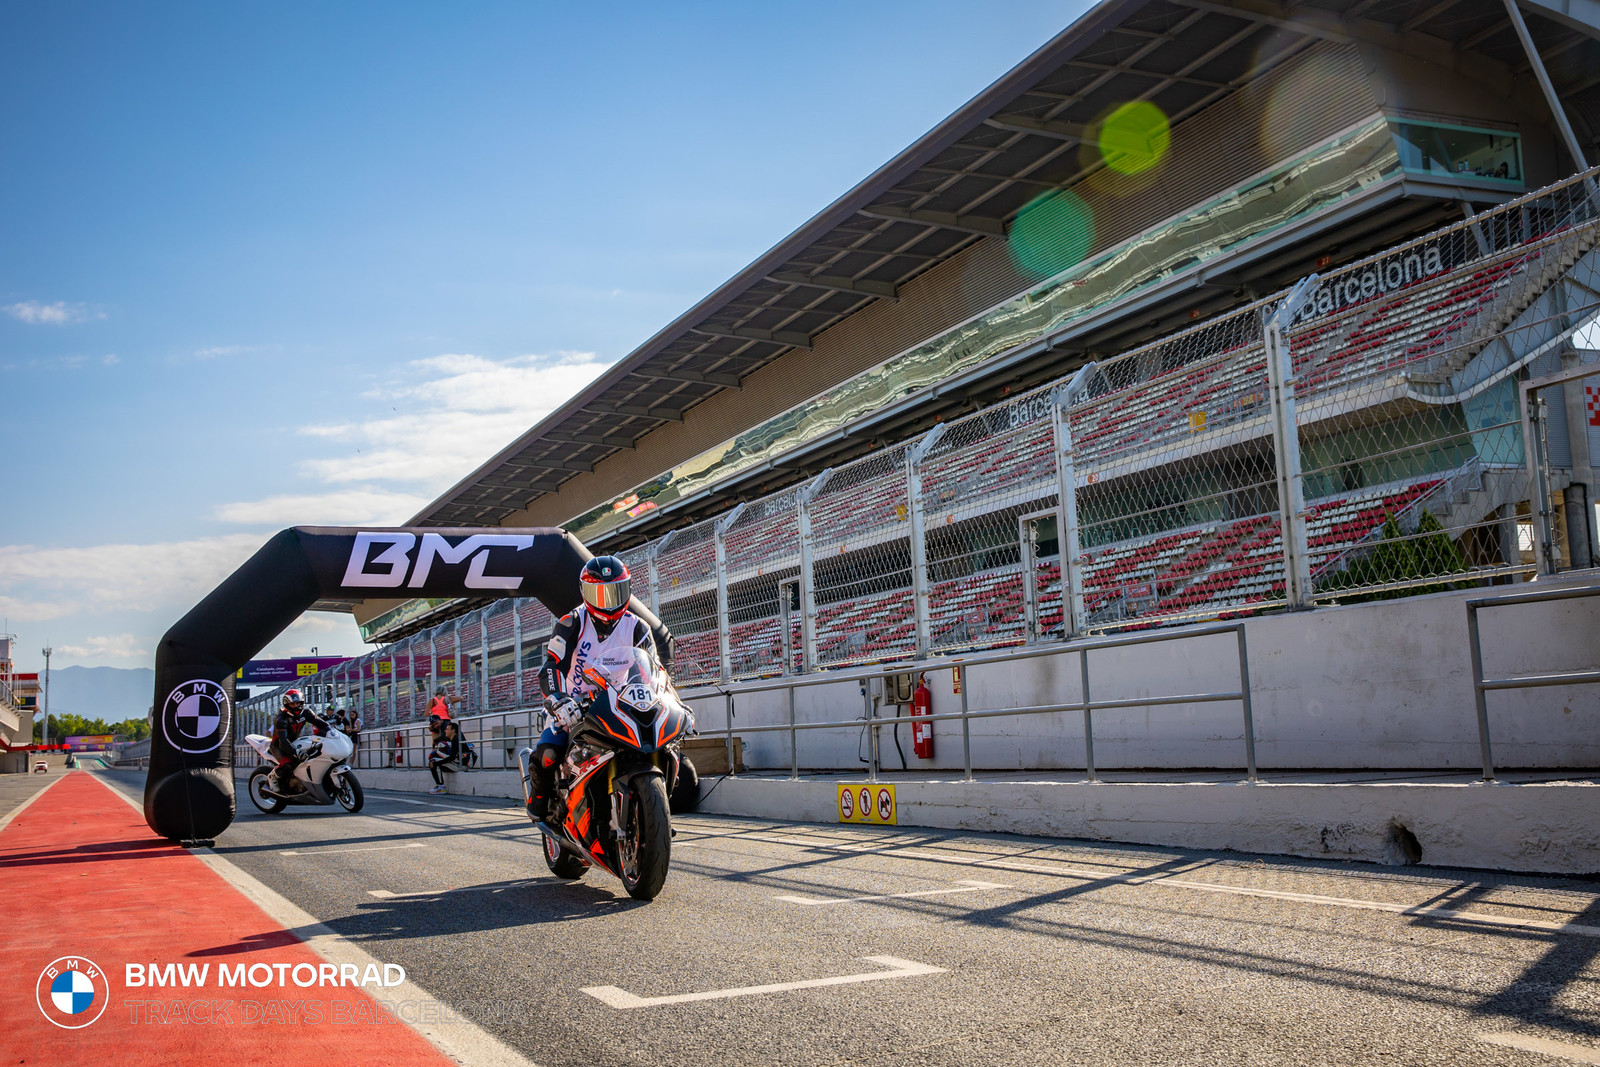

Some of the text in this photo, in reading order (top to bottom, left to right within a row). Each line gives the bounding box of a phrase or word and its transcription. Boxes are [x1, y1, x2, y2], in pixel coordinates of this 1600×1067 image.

[340, 531, 535, 590] BMC
[172, 683, 226, 704] BMW
[628, 688, 652, 701] 181
